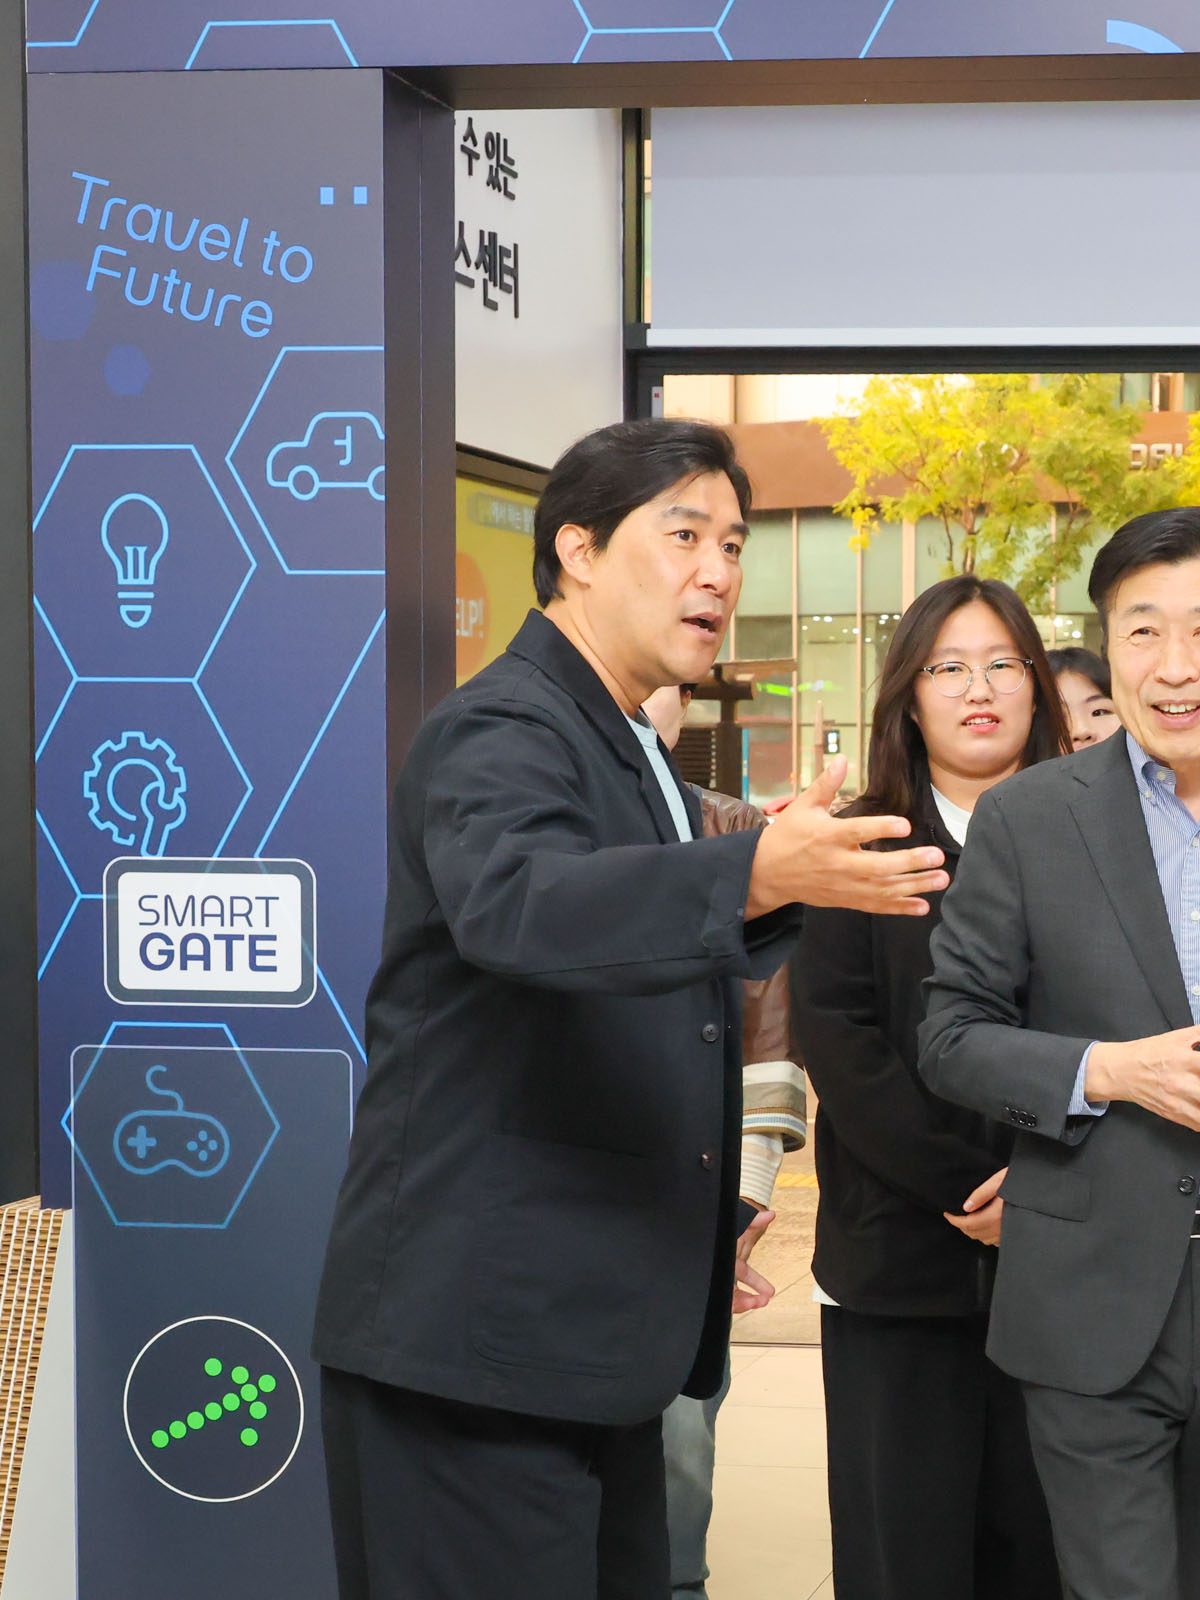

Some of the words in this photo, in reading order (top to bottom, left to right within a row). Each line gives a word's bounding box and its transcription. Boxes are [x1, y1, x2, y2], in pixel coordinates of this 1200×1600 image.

[460, 117, 480, 176] 수
[484, 131, 518, 200] 있는
[72, 171, 249, 268] Travel
[262, 230, 313, 283] to
[454, 220, 519, 319] 스센터
[85, 244, 273, 338] Future
[138, 894, 279, 928] SMART
[139, 932, 278, 972] GATE
